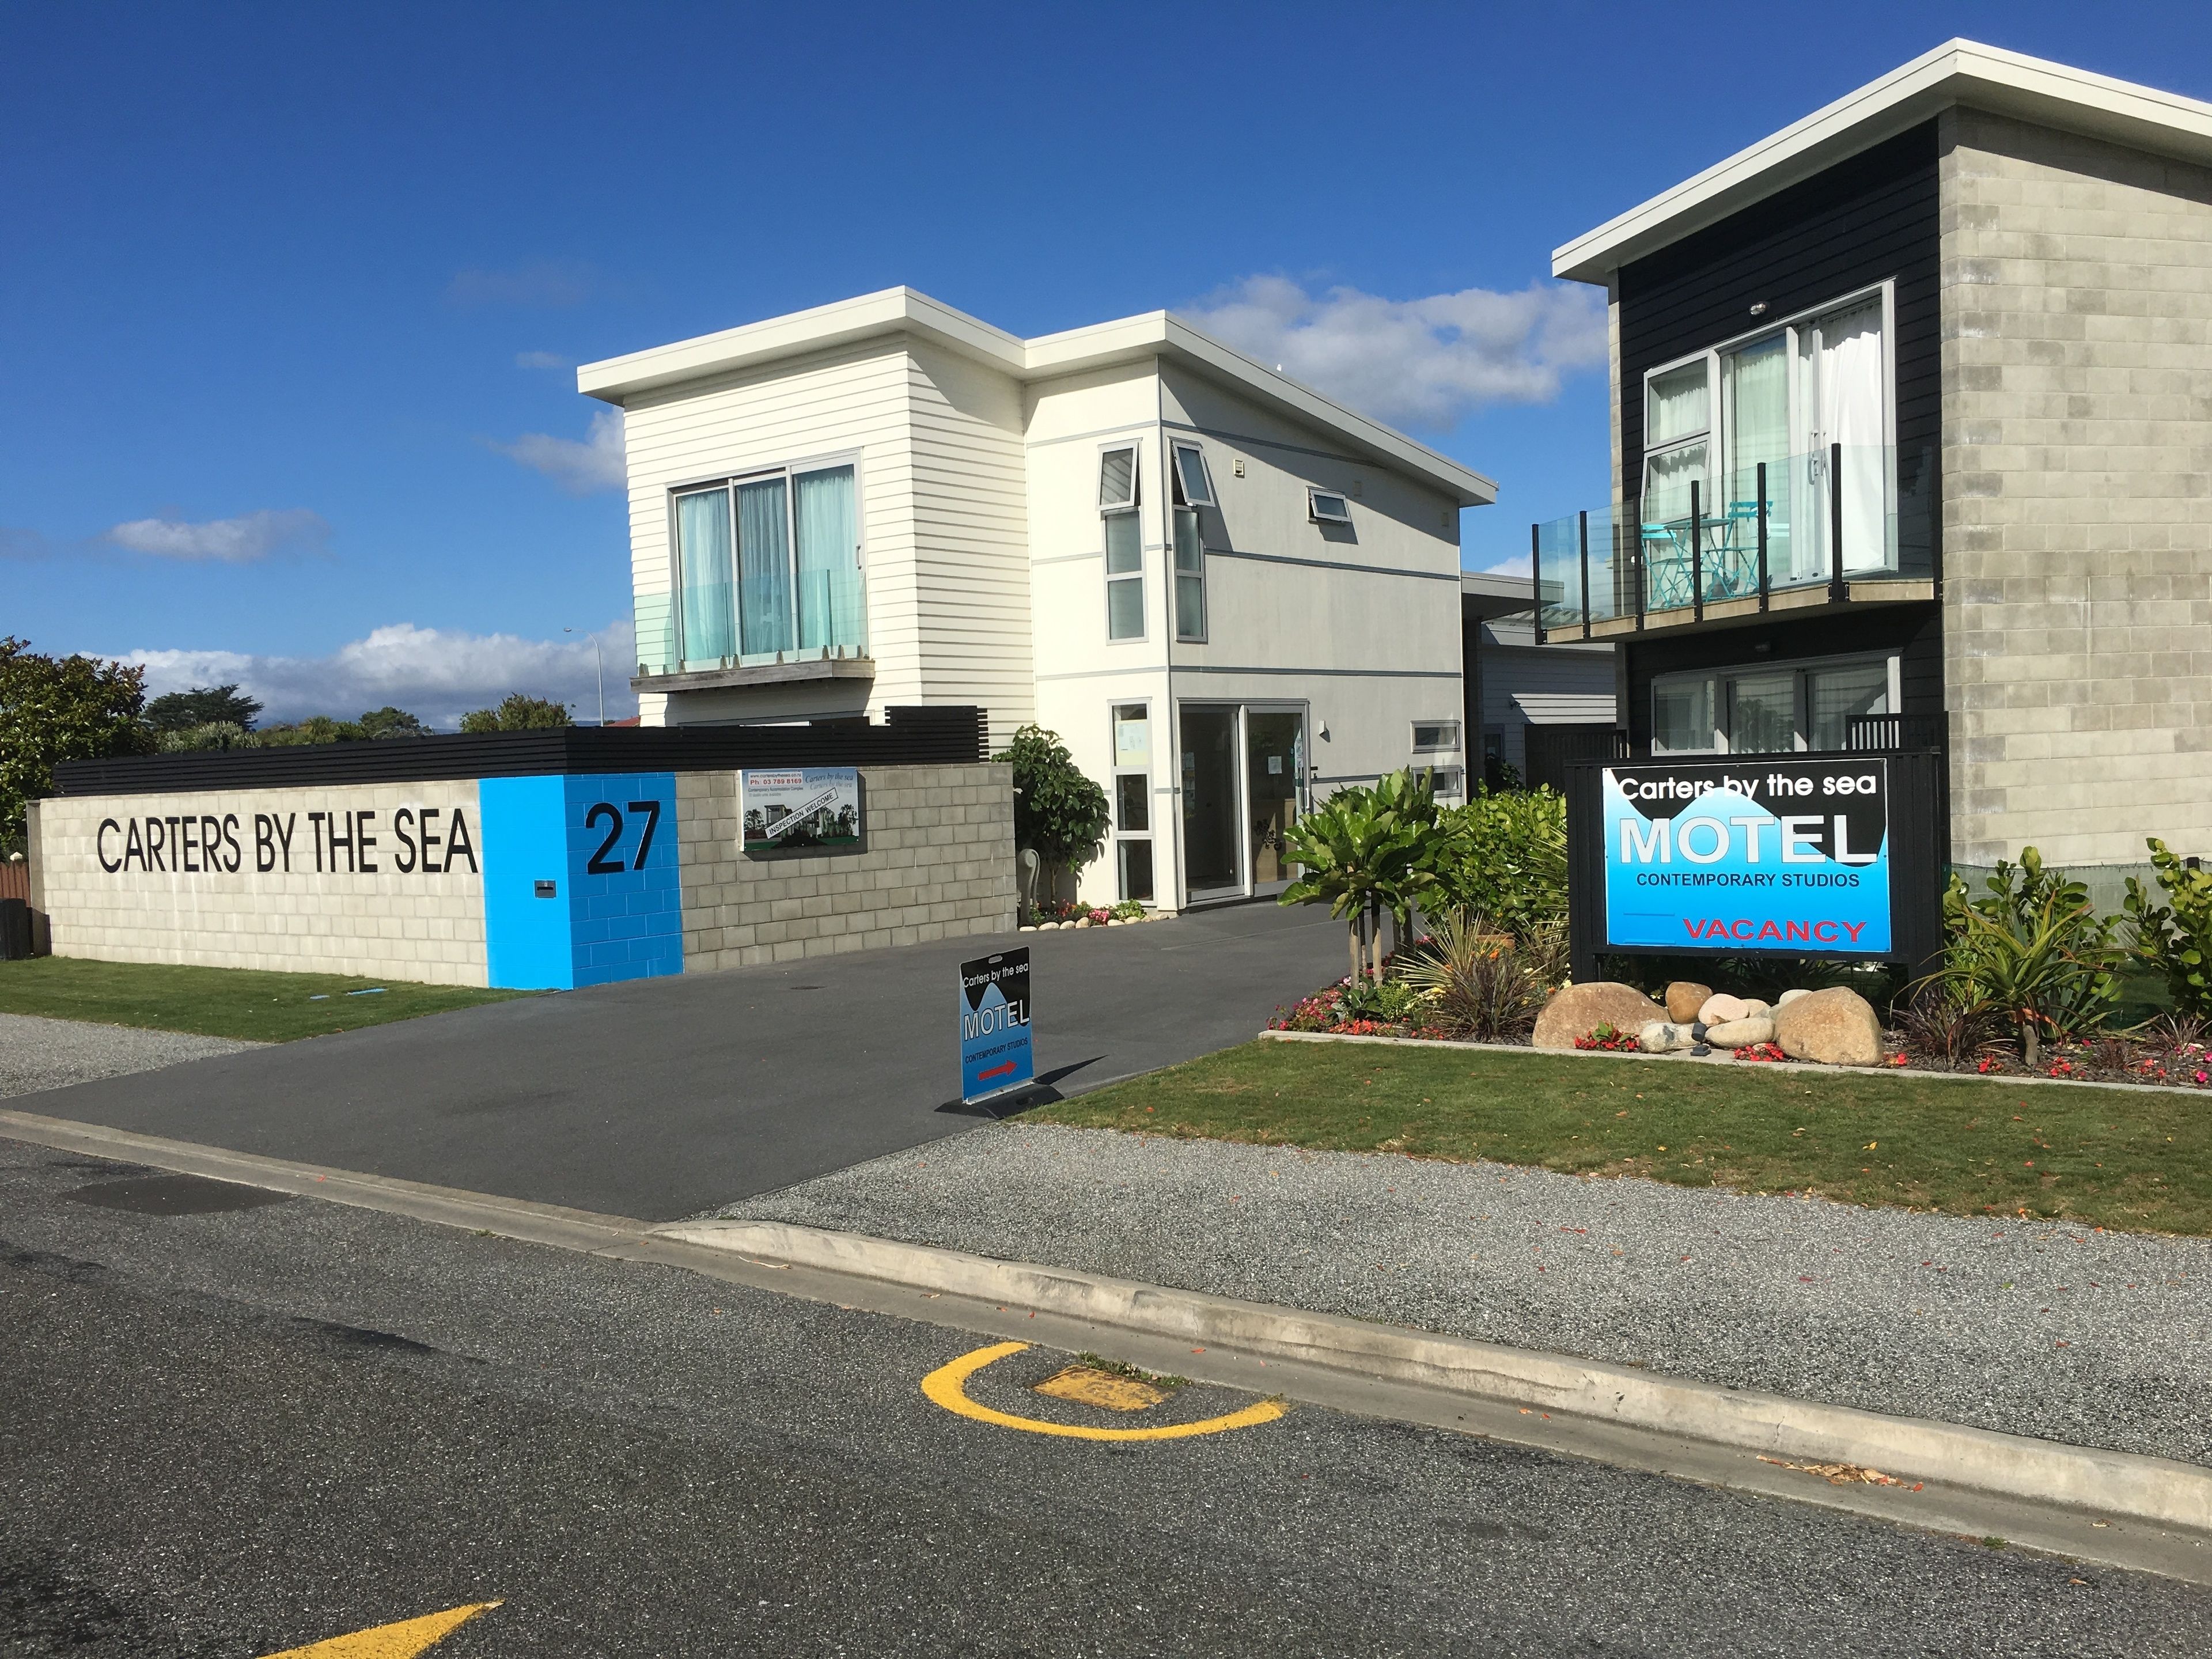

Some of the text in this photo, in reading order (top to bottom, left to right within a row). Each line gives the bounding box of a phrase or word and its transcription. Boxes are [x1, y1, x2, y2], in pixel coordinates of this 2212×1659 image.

[805, 775, 825, 783] Carters
[827, 772, 834, 781] by
[1618, 774, 1877, 801] Carters by the sea
[769, 793, 834, 835] INSPECTION WELCOME
[97, 808, 479, 873] CARTERS BY THE SEA
[585, 801, 661, 875] 27
[1619, 815, 1878, 865] MOTEL
[1637, 873, 1860, 888] CONTEMPORARY STUDIOS
[1682, 918, 1868, 943] VACANCY
[963, 962, 1028, 988] Carters by the sea
[964, 999, 1031, 1041] MOTEL
[965, 1037, 1028, 1063] CONTEMPORARY STUDIOS
